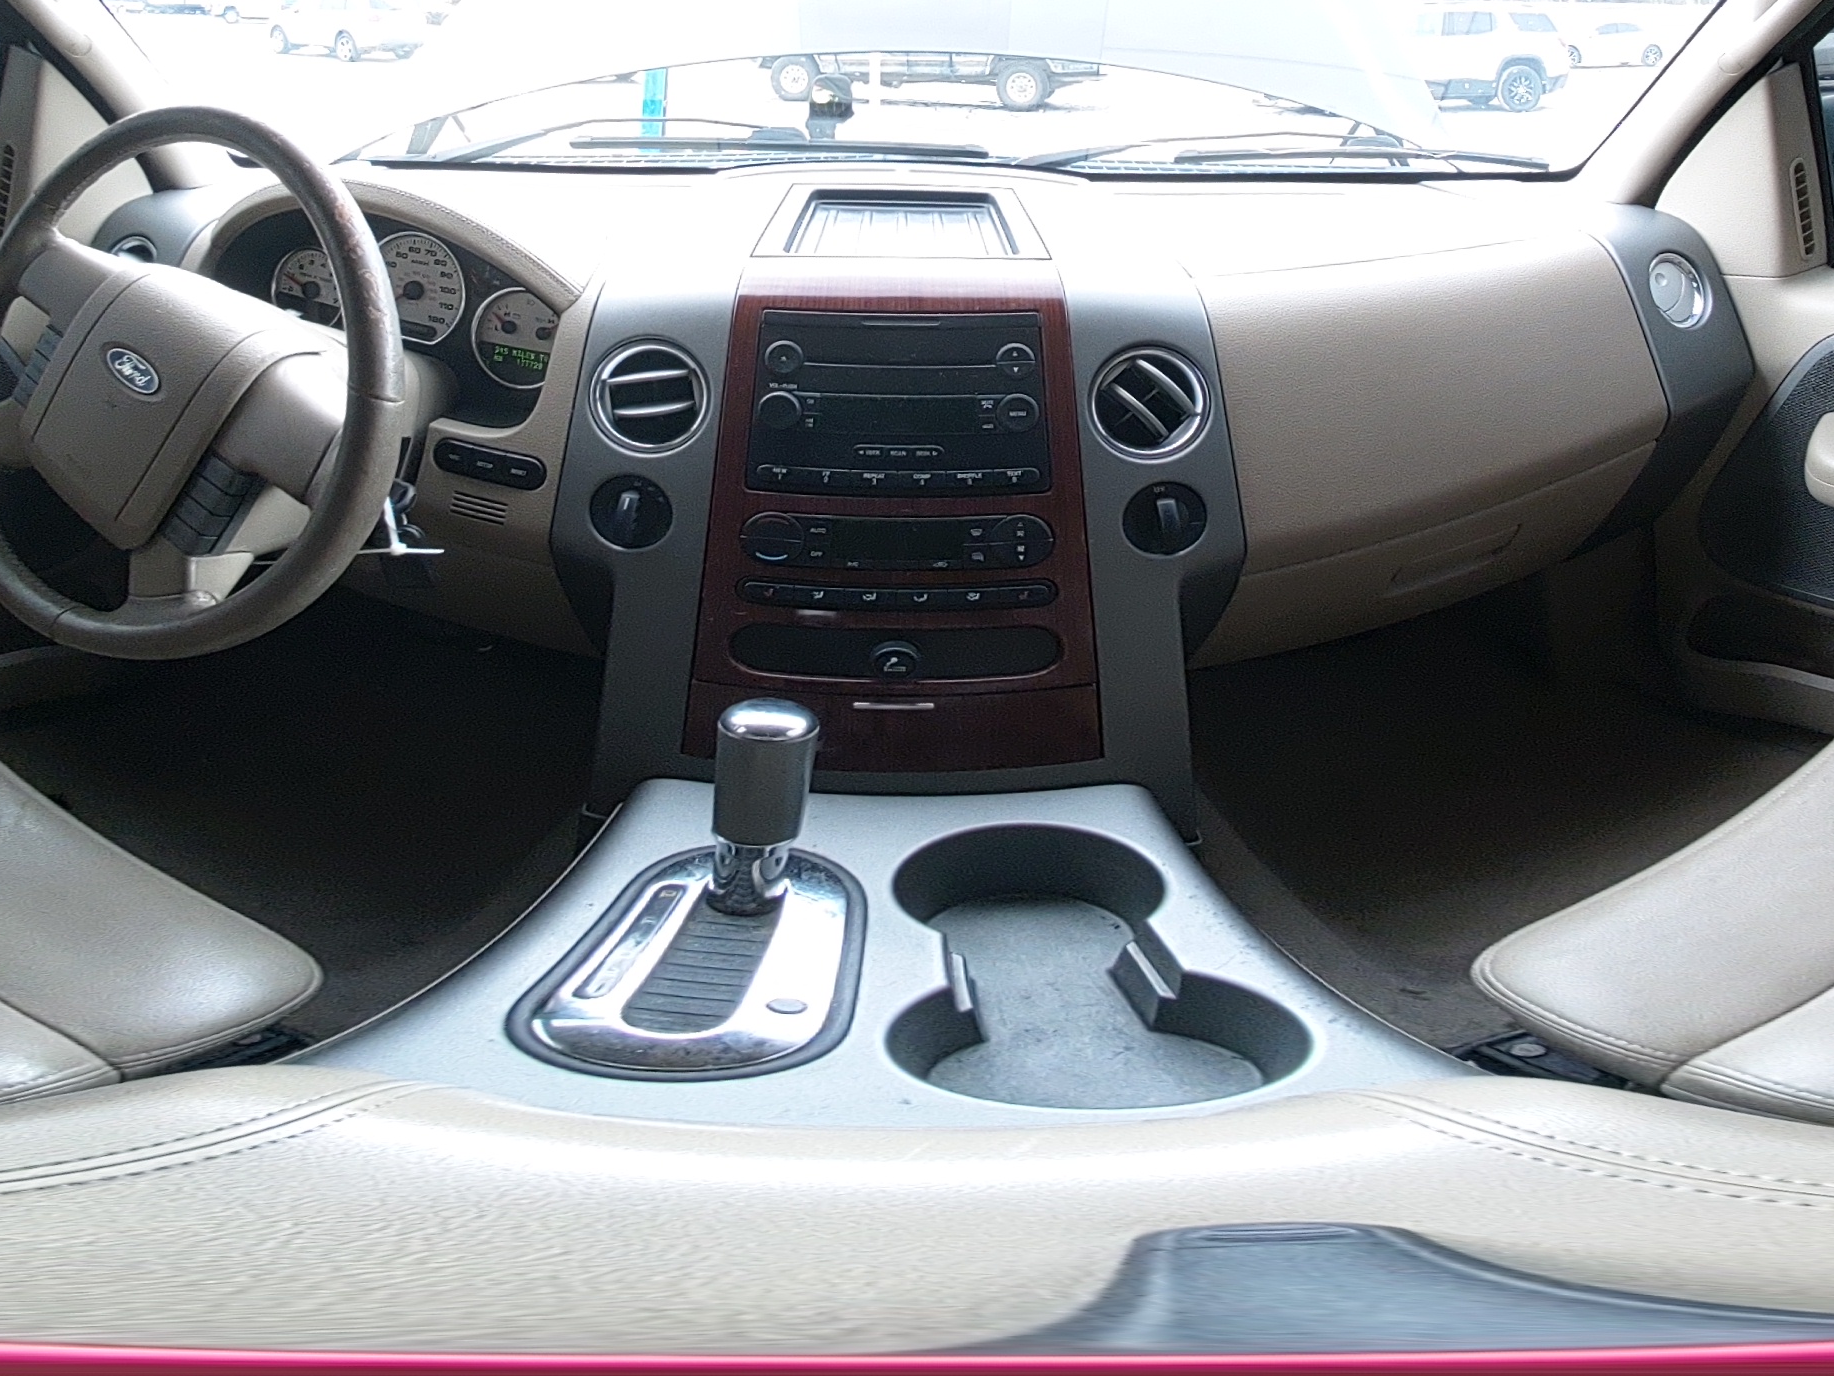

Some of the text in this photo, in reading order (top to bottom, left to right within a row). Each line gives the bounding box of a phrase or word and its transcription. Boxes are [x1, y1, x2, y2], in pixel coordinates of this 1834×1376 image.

[409, 246, 421, 254] 60
[425, 249, 437, 257] 70
[395, 251, 408, 259] 50
[440, 271, 453, 279] 90
[439, 286, 456, 295] 100
[439, 302, 454, 310] 110
[428, 315, 445, 324] 120
[115, 355, 152, 386] Ford
